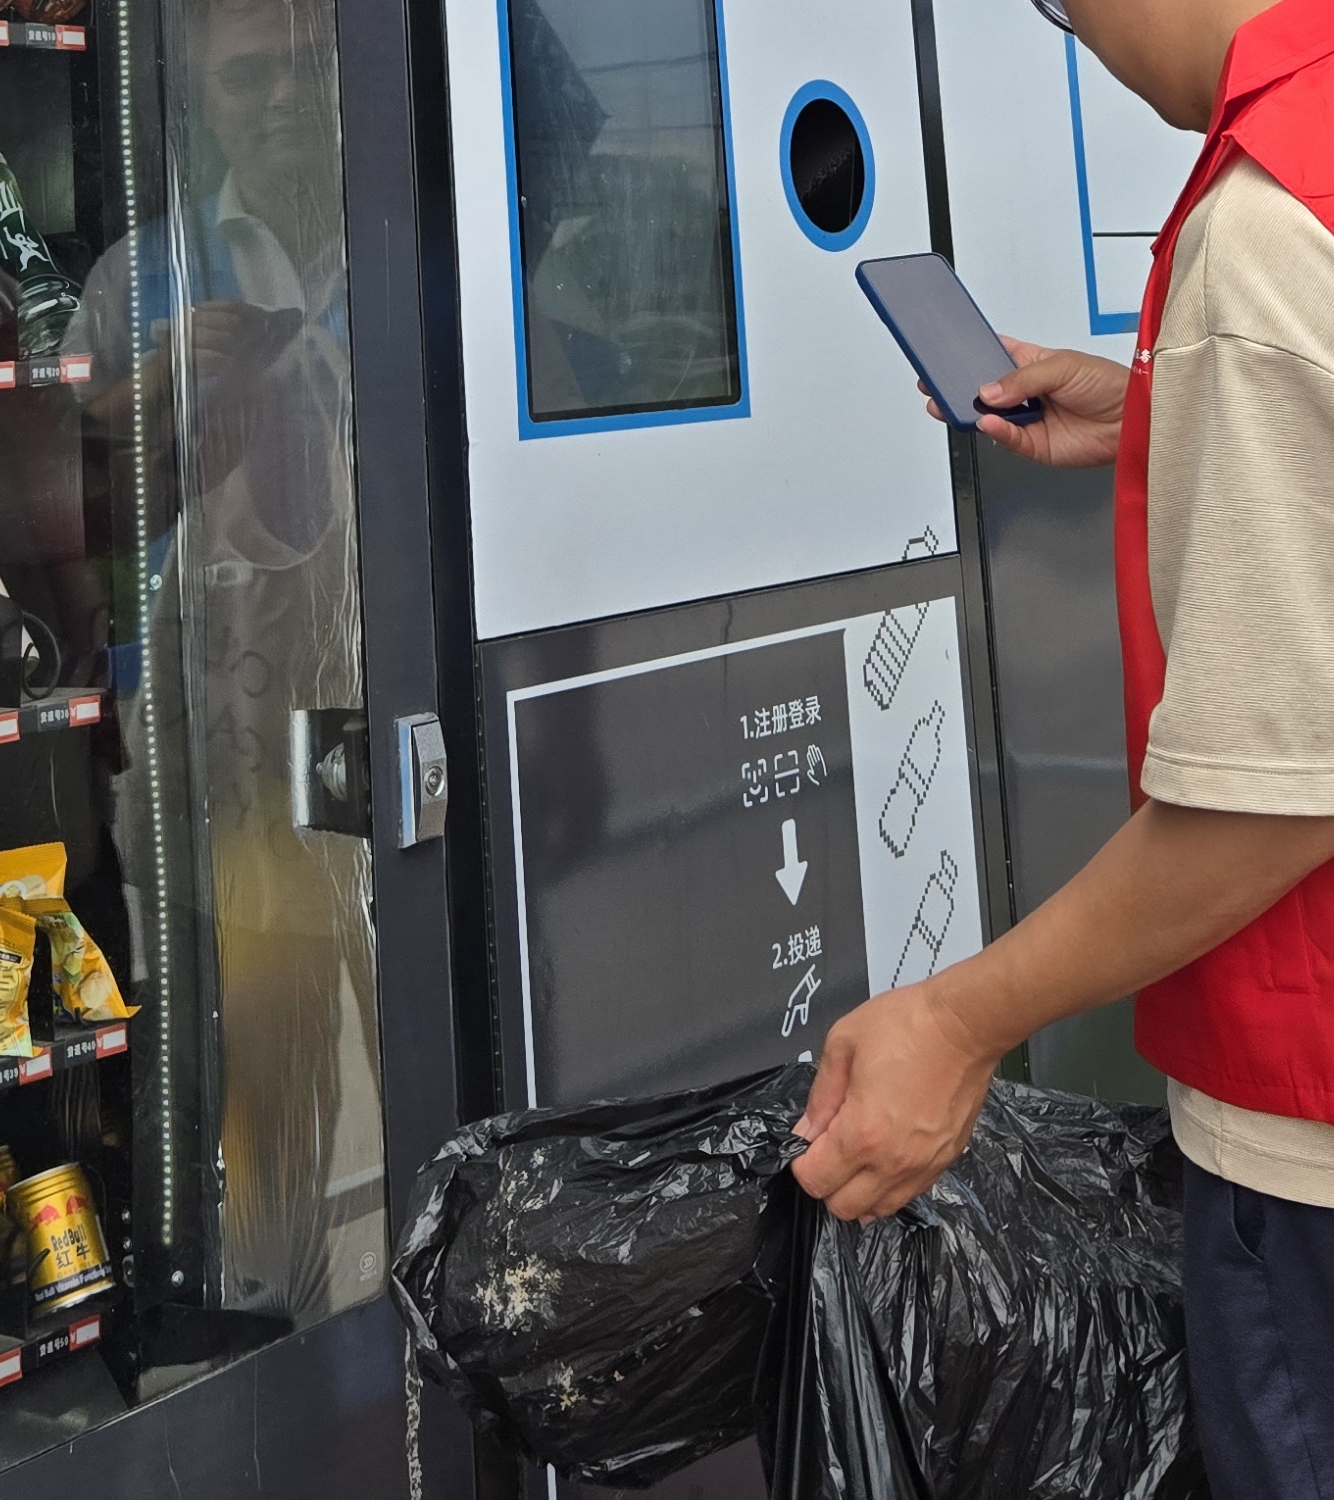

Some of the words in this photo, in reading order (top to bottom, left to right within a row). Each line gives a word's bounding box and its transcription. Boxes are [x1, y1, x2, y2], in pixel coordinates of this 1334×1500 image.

[740, 696, 822, 740] 1.注册登录
[771, 925, 823, 970] 2.投递
